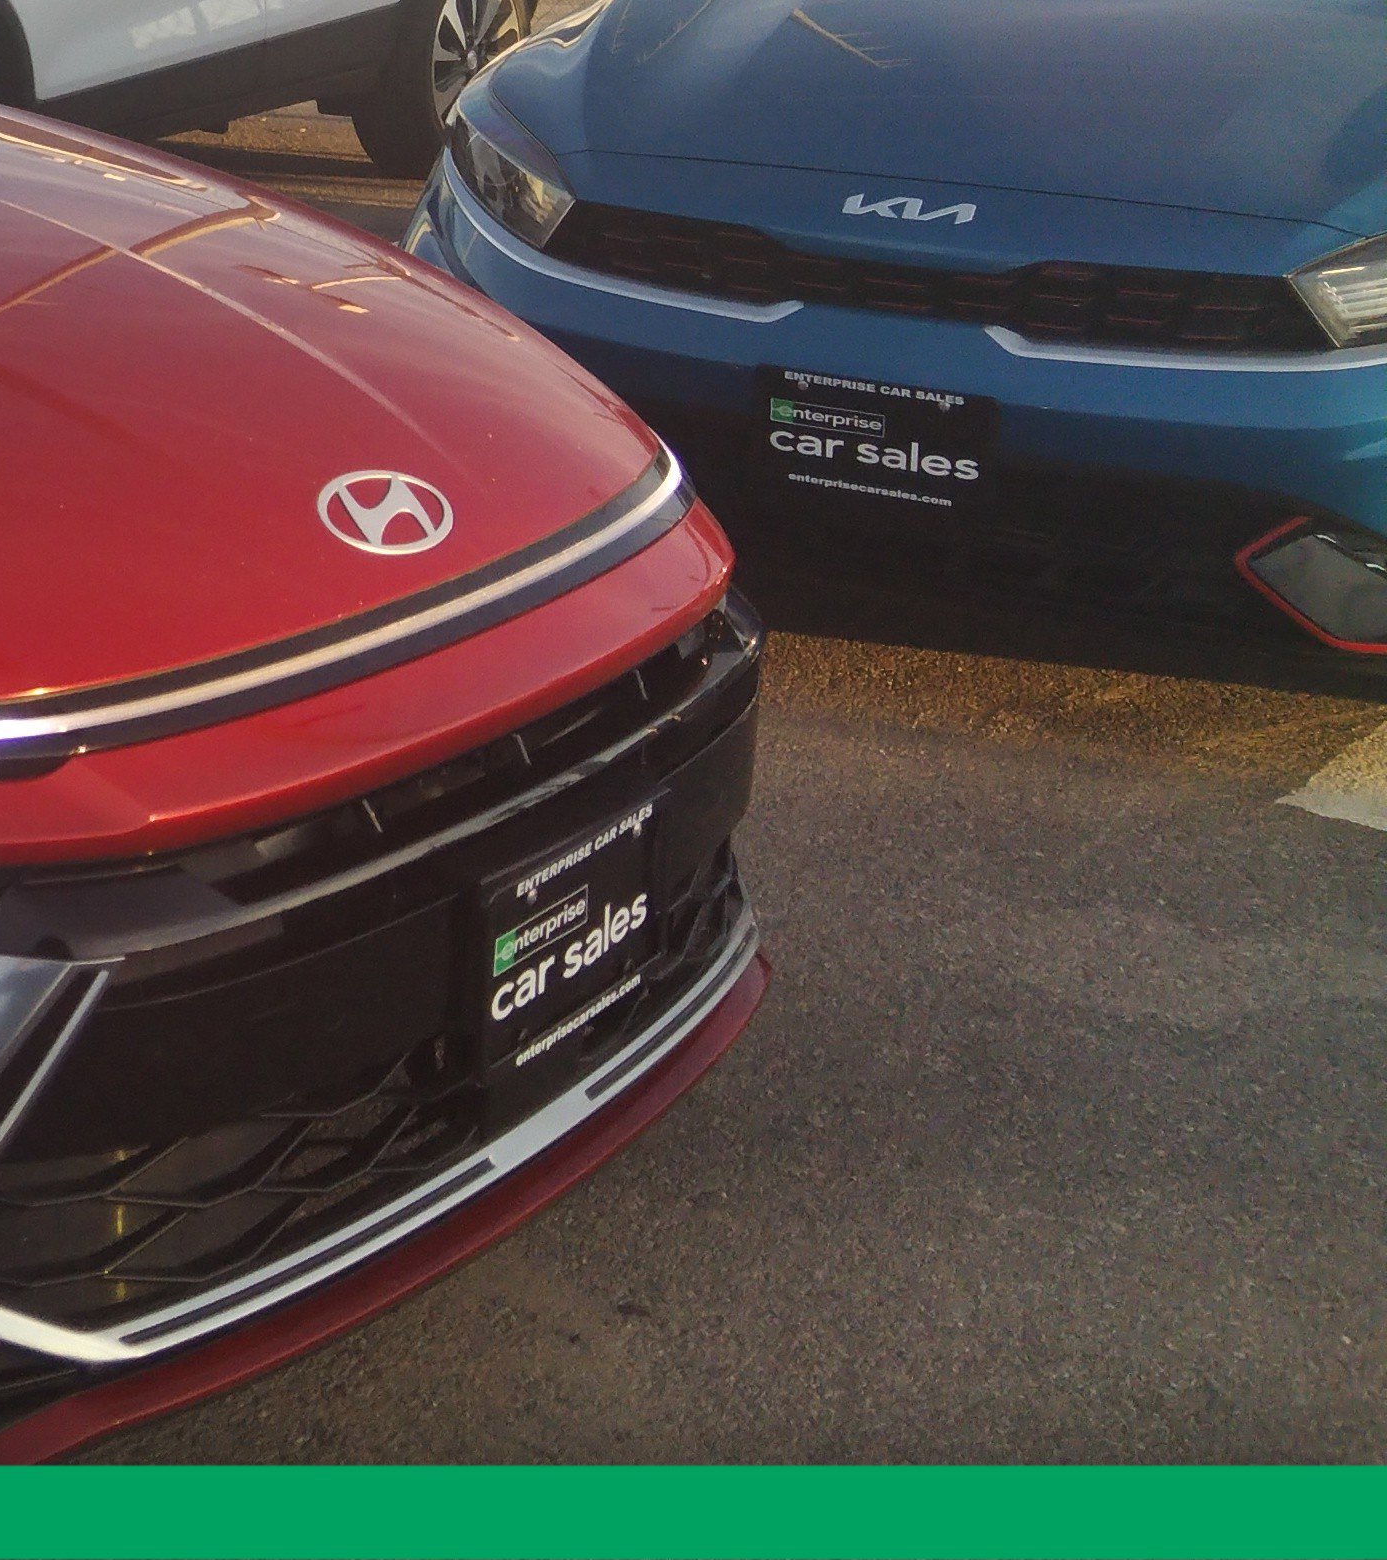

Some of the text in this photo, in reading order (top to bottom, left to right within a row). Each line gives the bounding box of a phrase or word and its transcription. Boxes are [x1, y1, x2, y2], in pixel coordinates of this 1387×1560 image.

[842, 193, 977, 225] KIA
[784, 370, 965, 406] ENTERPRISE CAR SALES
[778, 404, 883, 431] enterprise
[769, 430, 980, 481] car sales
[788, 472, 953, 507] enterprisecarsales.com
[516, 803, 653, 898] ENTERPRISE CAR SALES
[500, 897, 586, 962] enterprise
[491, 893, 648, 1022] car sales
[515, 974, 642, 1068] enterprisecarsales.com
